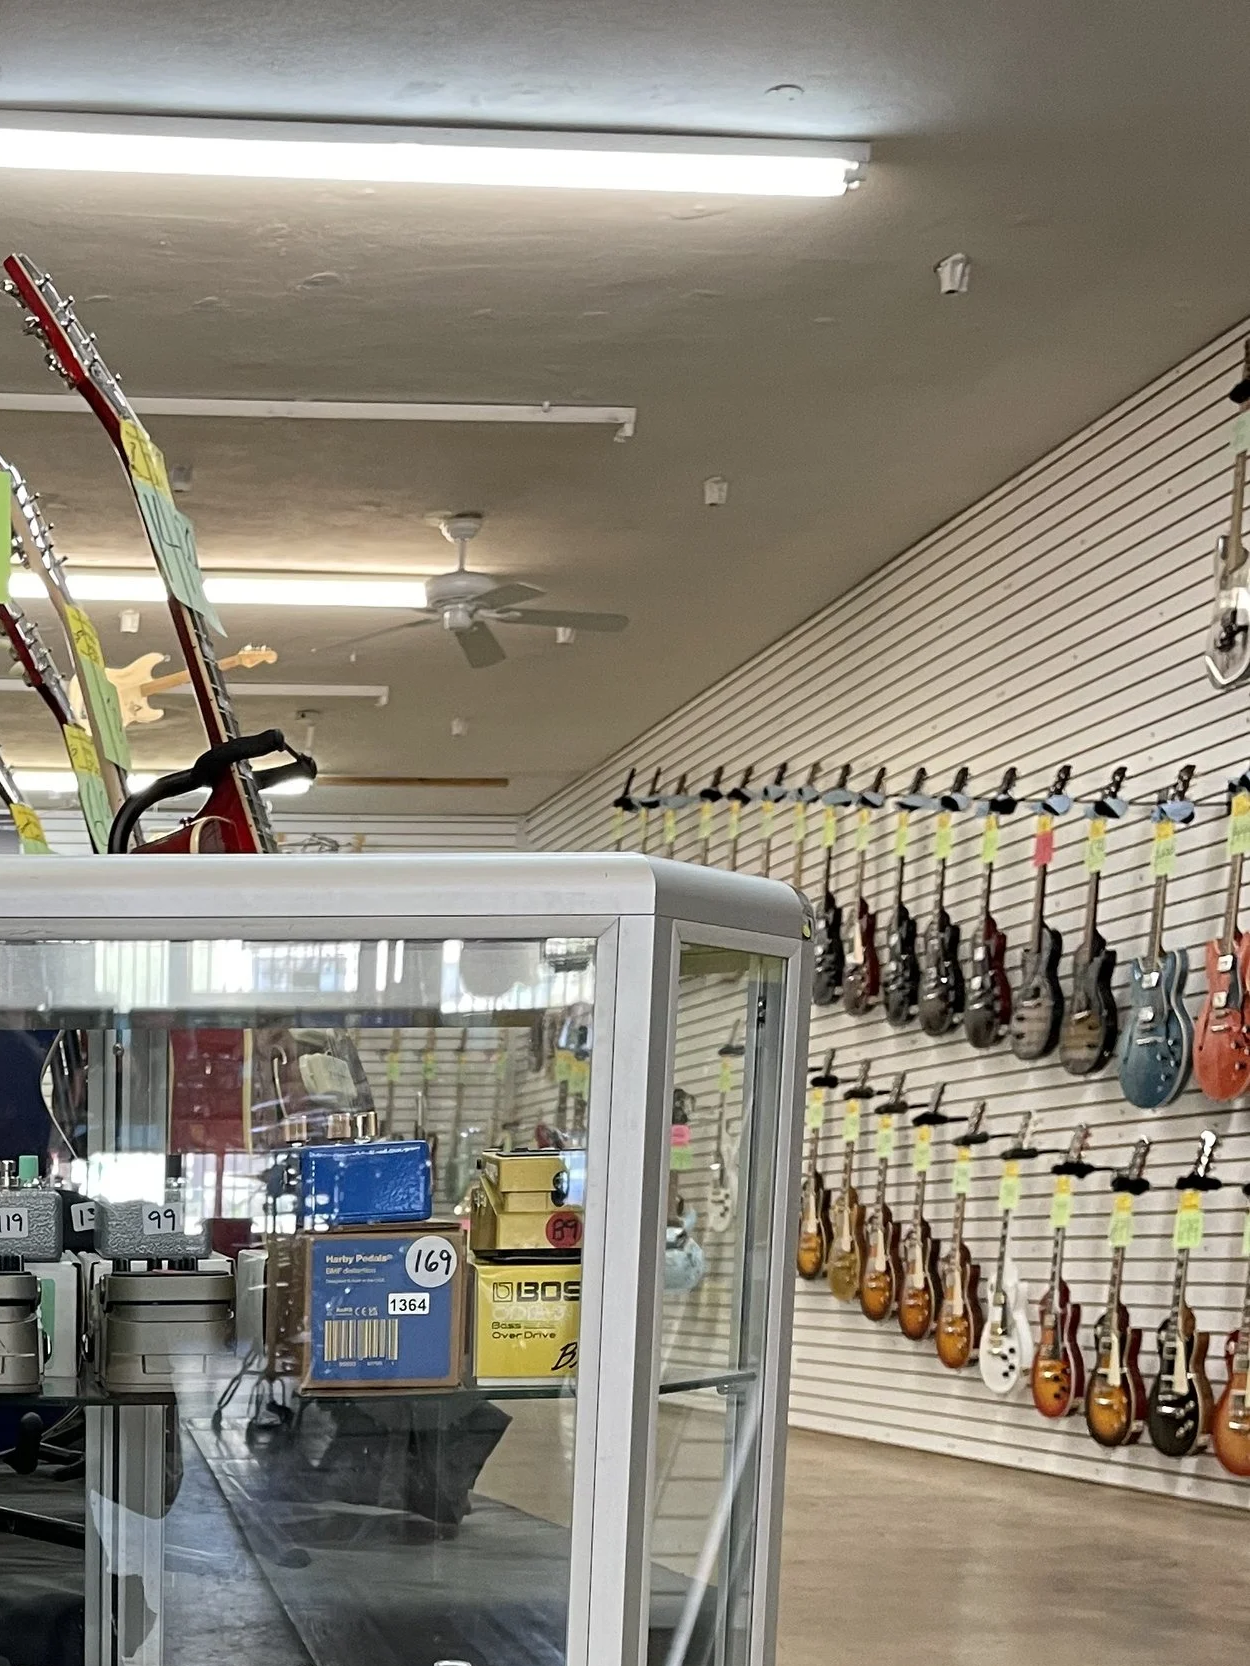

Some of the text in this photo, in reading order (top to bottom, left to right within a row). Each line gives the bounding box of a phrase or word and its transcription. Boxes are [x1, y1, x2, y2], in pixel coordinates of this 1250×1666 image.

[148, 1208, 176, 1231] 99
[326, 1255, 354, 1265] Harby
[414, 1249, 453, 1276] 169
[516, 1280, 581, 1303] BOS
[389, 1298, 427, 1312] 1364
[491, 1321, 522, 1330] Bass
